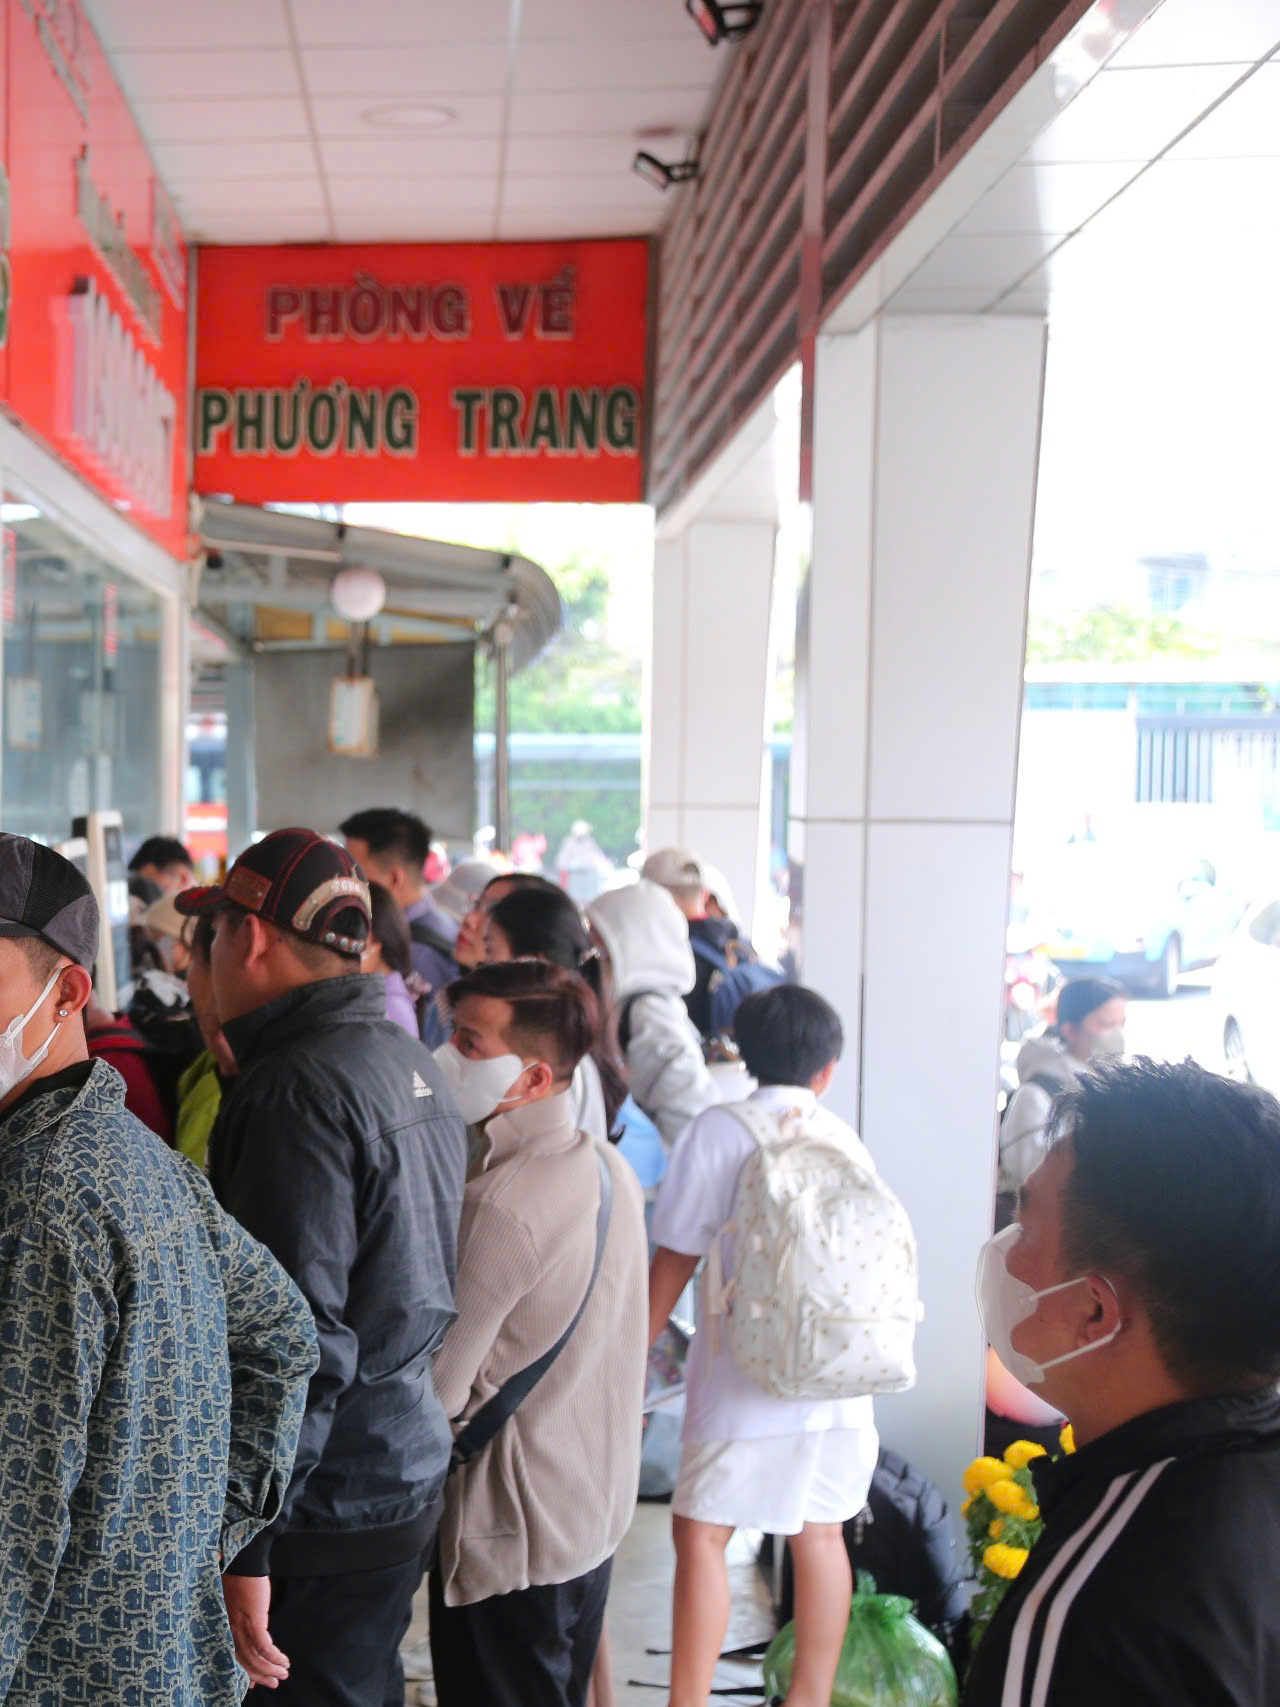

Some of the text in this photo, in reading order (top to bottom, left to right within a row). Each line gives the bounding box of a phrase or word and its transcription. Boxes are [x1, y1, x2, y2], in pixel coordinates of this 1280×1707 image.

[266, 263, 578, 341] PHÒNG VÉ
[198, 377, 639, 457] PHƯƠNG TRANG
